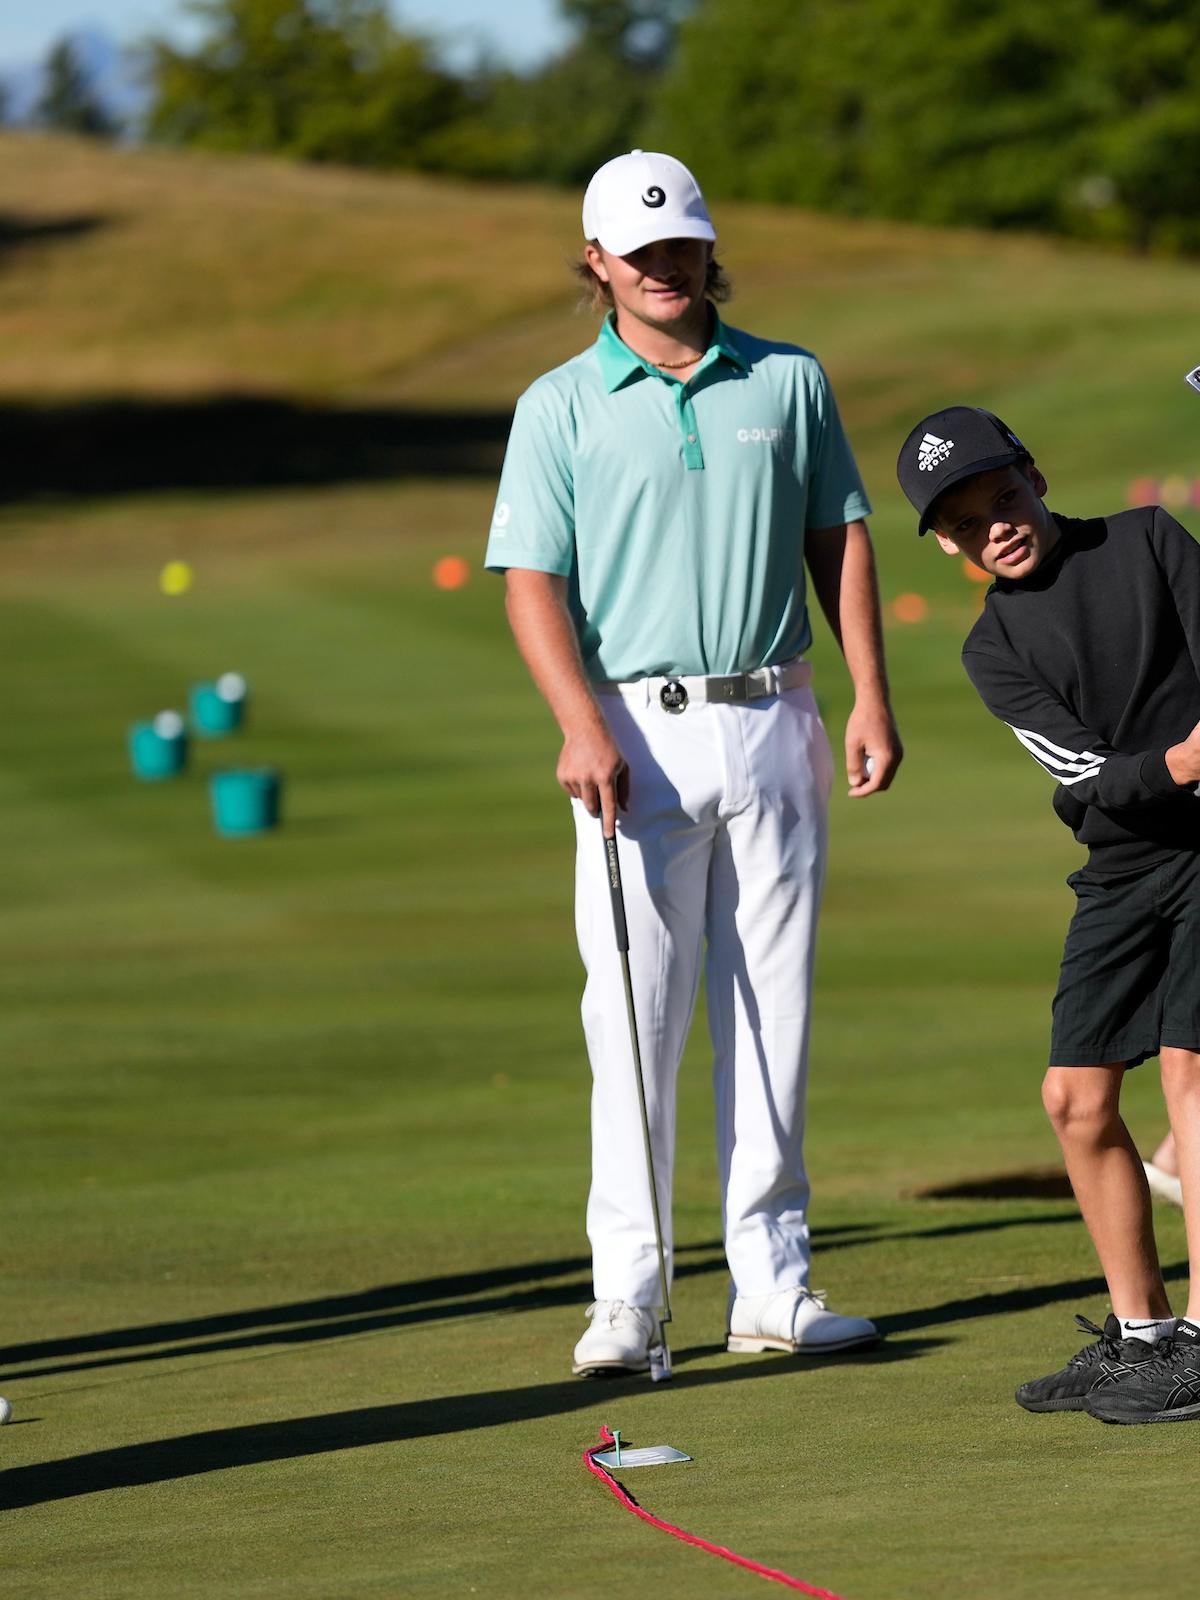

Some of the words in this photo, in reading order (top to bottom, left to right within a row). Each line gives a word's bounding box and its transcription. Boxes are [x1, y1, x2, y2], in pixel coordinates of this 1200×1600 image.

[918, 440, 955, 471] adidas
[927, 450, 951, 472] GOLF
[606, 840, 619, 889] CAMERON
